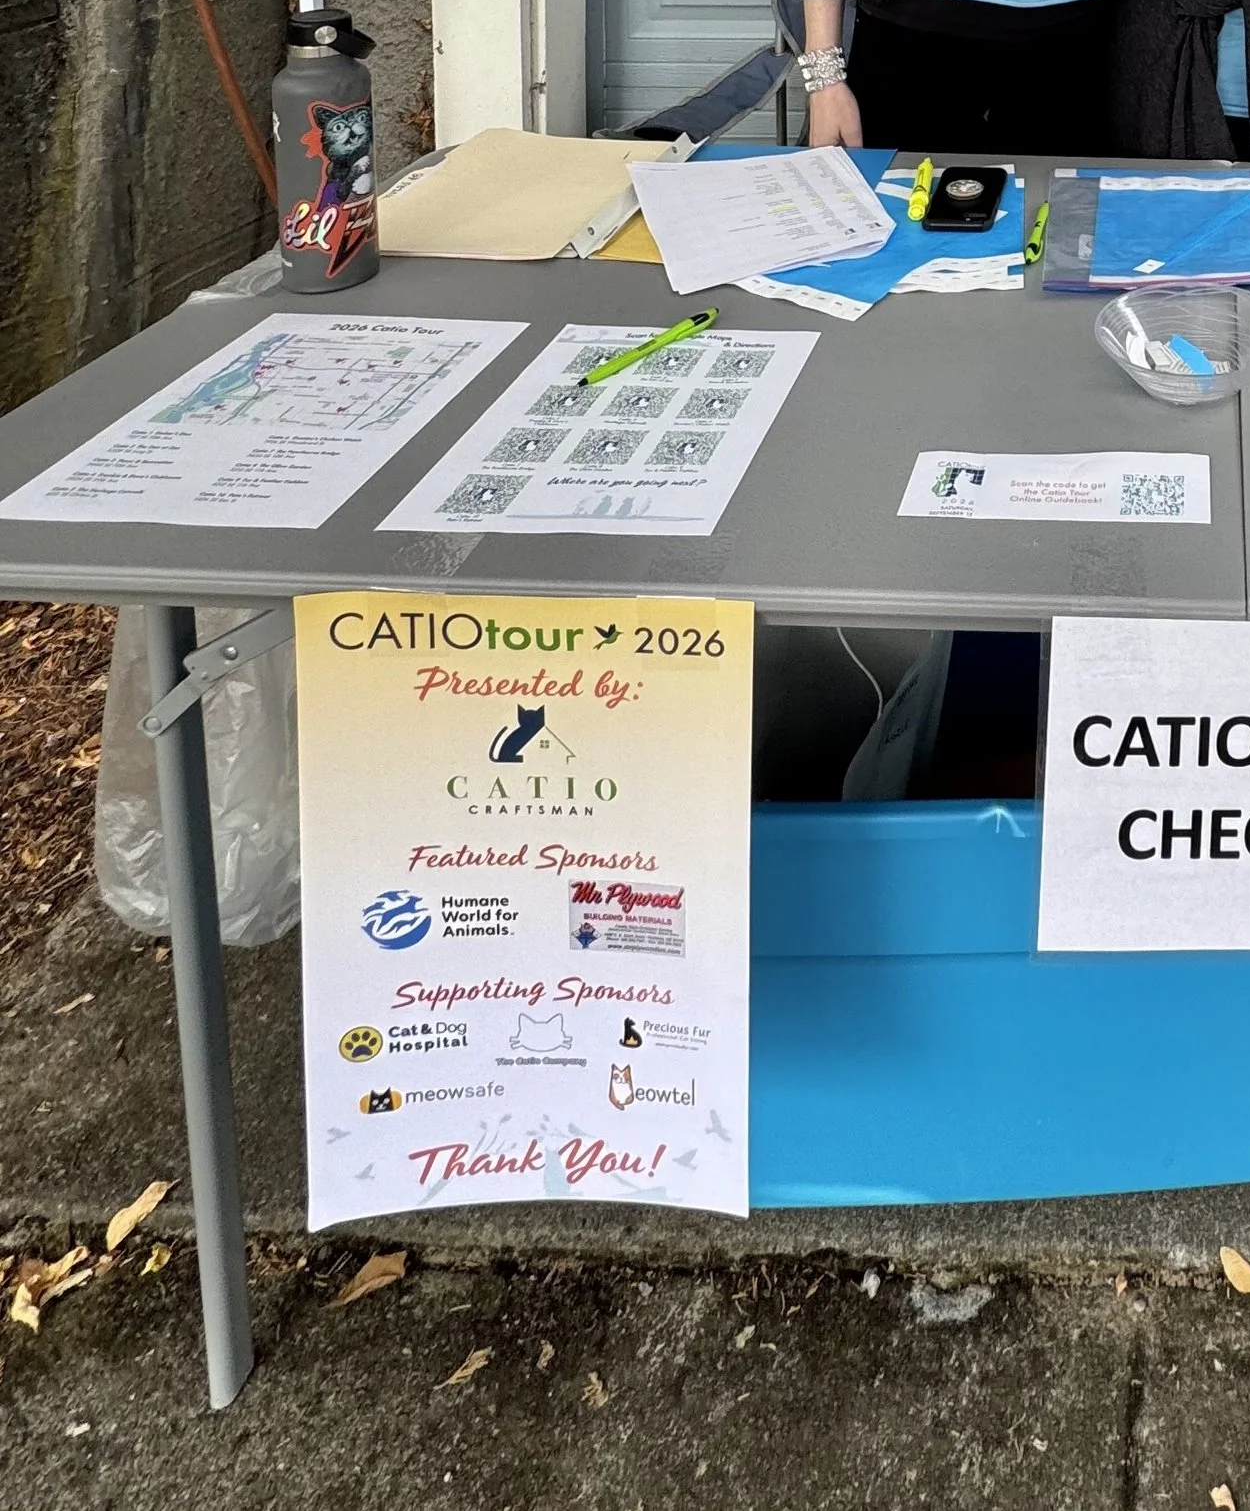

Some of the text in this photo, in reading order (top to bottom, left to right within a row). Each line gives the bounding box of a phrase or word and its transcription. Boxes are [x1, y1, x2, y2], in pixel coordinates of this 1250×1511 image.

[285, 202, 340, 250] Lil
[371, 325, 408, 333] Catio
[412, 327, 444, 335] Tour
[610, 479, 632, 487] you
[635, 479, 667, 487] going
[1091, 482, 1106, 490] get
[330, 612, 725, 657] CATIOtour 2026
[414, 666, 644, 709] Presented by:
[447, 775, 618, 801] CATIO
[469, 804, 594, 816] CRAFTSMAN
[409, 845, 659, 875] Featured Sponsors
[441, 896, 509, 908] Humane
[571, 881, 684, 913] Mr Plywood
[442, 908, 519, 923] World for
[626, 914, 672, 926] MATERIALS
[391, 977, 675, 1011] Supporting Sponsors
[388, 1021, 467, 1039] Cat & Dog
[643, 1021, 711, 1037] Precious Fur
[388, 1036, 468, 1054] Hospital
[496, 1057, 514, 1066] The
[542, 1057, 587, 1067] Company
[405, 1082, 505, 1105] meowsafe
[409, 1139, 667, 1186] Thank You!
